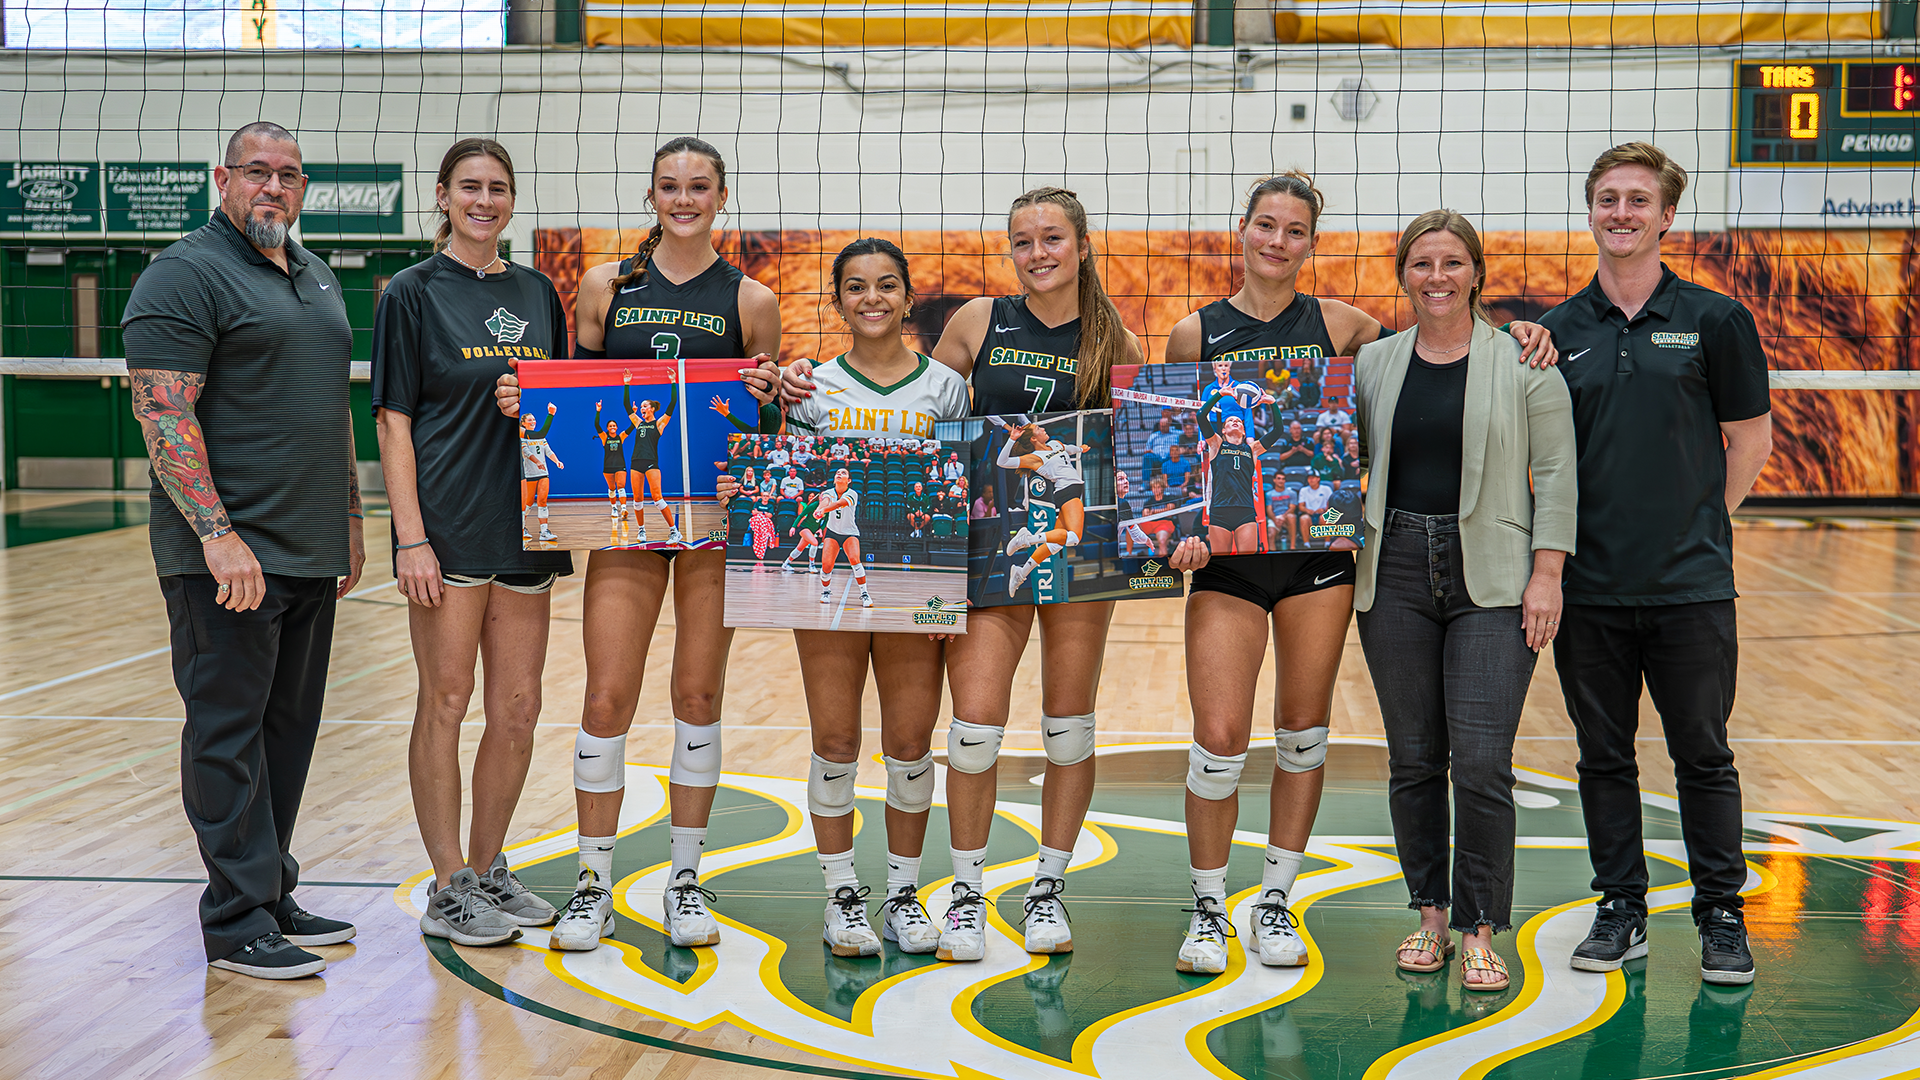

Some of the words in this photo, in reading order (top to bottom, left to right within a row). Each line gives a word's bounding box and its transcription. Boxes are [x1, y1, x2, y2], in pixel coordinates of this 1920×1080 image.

[1759, 65, 1815, 89] TARS
[1789, 92, 1820, 139] 0
[1841, 133, 1914, 152] PERIOD
[7, 163, 89, 188] JARRETT
[107, 166, 160, 184] Edward
[161, 167, 206, 185] Jones
[30, 182, 68, 198] Ford
[615, 307, 682, 328] SAINT
[682, 311, 726, 336] LEO
[1652, 332, 1681, 341] SAINT
[1681, 333, 1699, 341] LEO
[989, 346, 1055, 370] SAINT
[1280, 344, 1323, 360] LEO
[1024, 374, 1056, 414] 7
[828, 407, 894, 432] SAINT
[900, 410, 935, 439] LEO
[535, 445, 541, 455] 2
[1060, 454, 1068, 465] 7
[1233, 455, 1241, 470] 1
[836, 509, 842, 520] 5
[1310, 525, 1337, 534] SAINT
[1338, 524, 1356, 532] LEO
[1129, 577, 1156, 586] SAINT
[1157, 576, 1174, 584] LEO
[913, 612, 939, 621] SAINT
[940, 613, 957, 622] LEO
